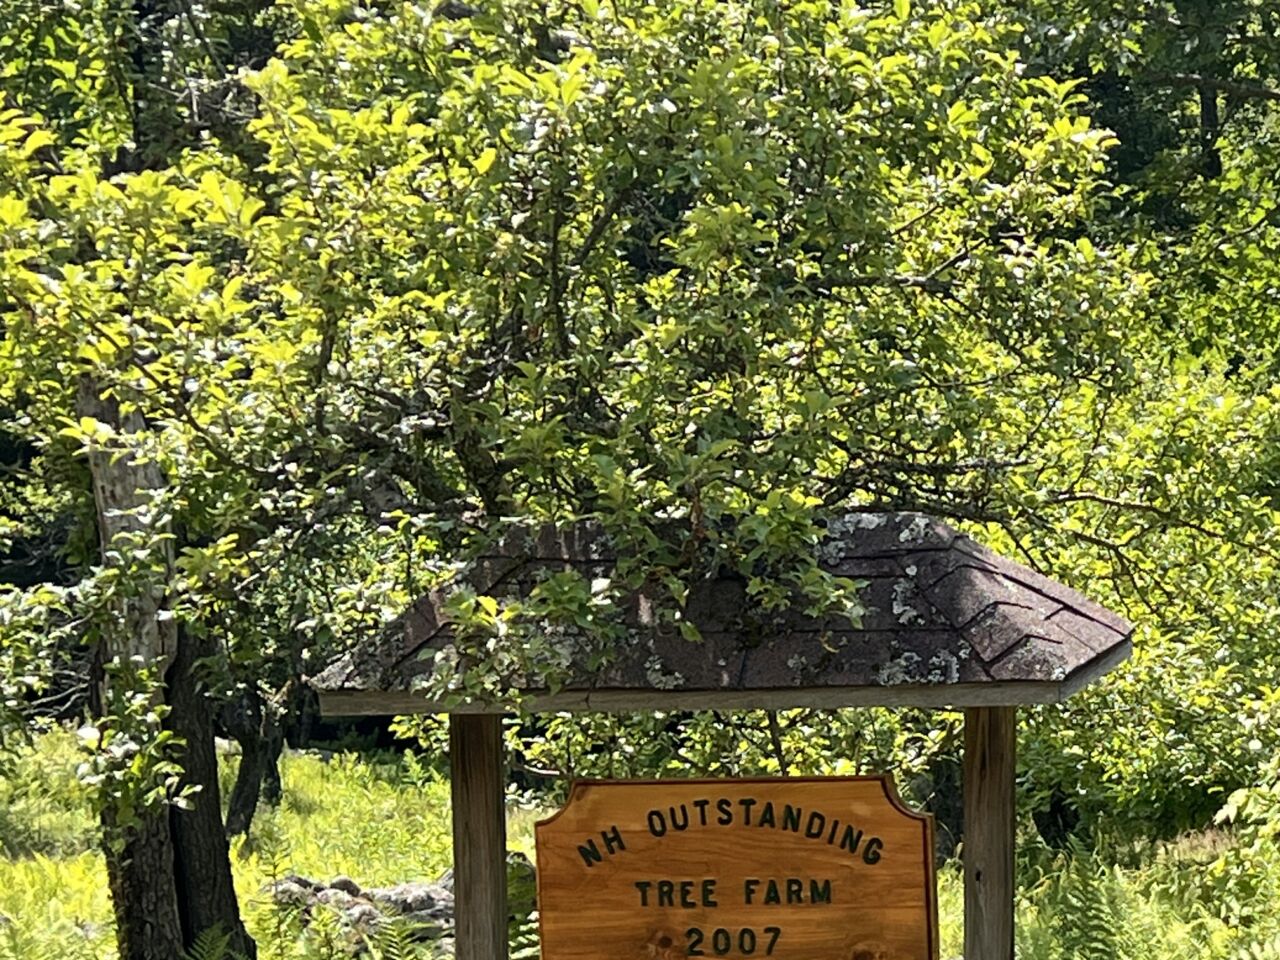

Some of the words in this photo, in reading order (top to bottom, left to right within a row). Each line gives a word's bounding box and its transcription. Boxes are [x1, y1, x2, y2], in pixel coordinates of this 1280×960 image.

[577, 826, 626, 867] NH
[647, 798, 884, 865] OUTSTANDING
[634, 879, 718, 908] TREE
[743, 879, 833, 906] FARM
[685, 926, 781, 956] 2007
